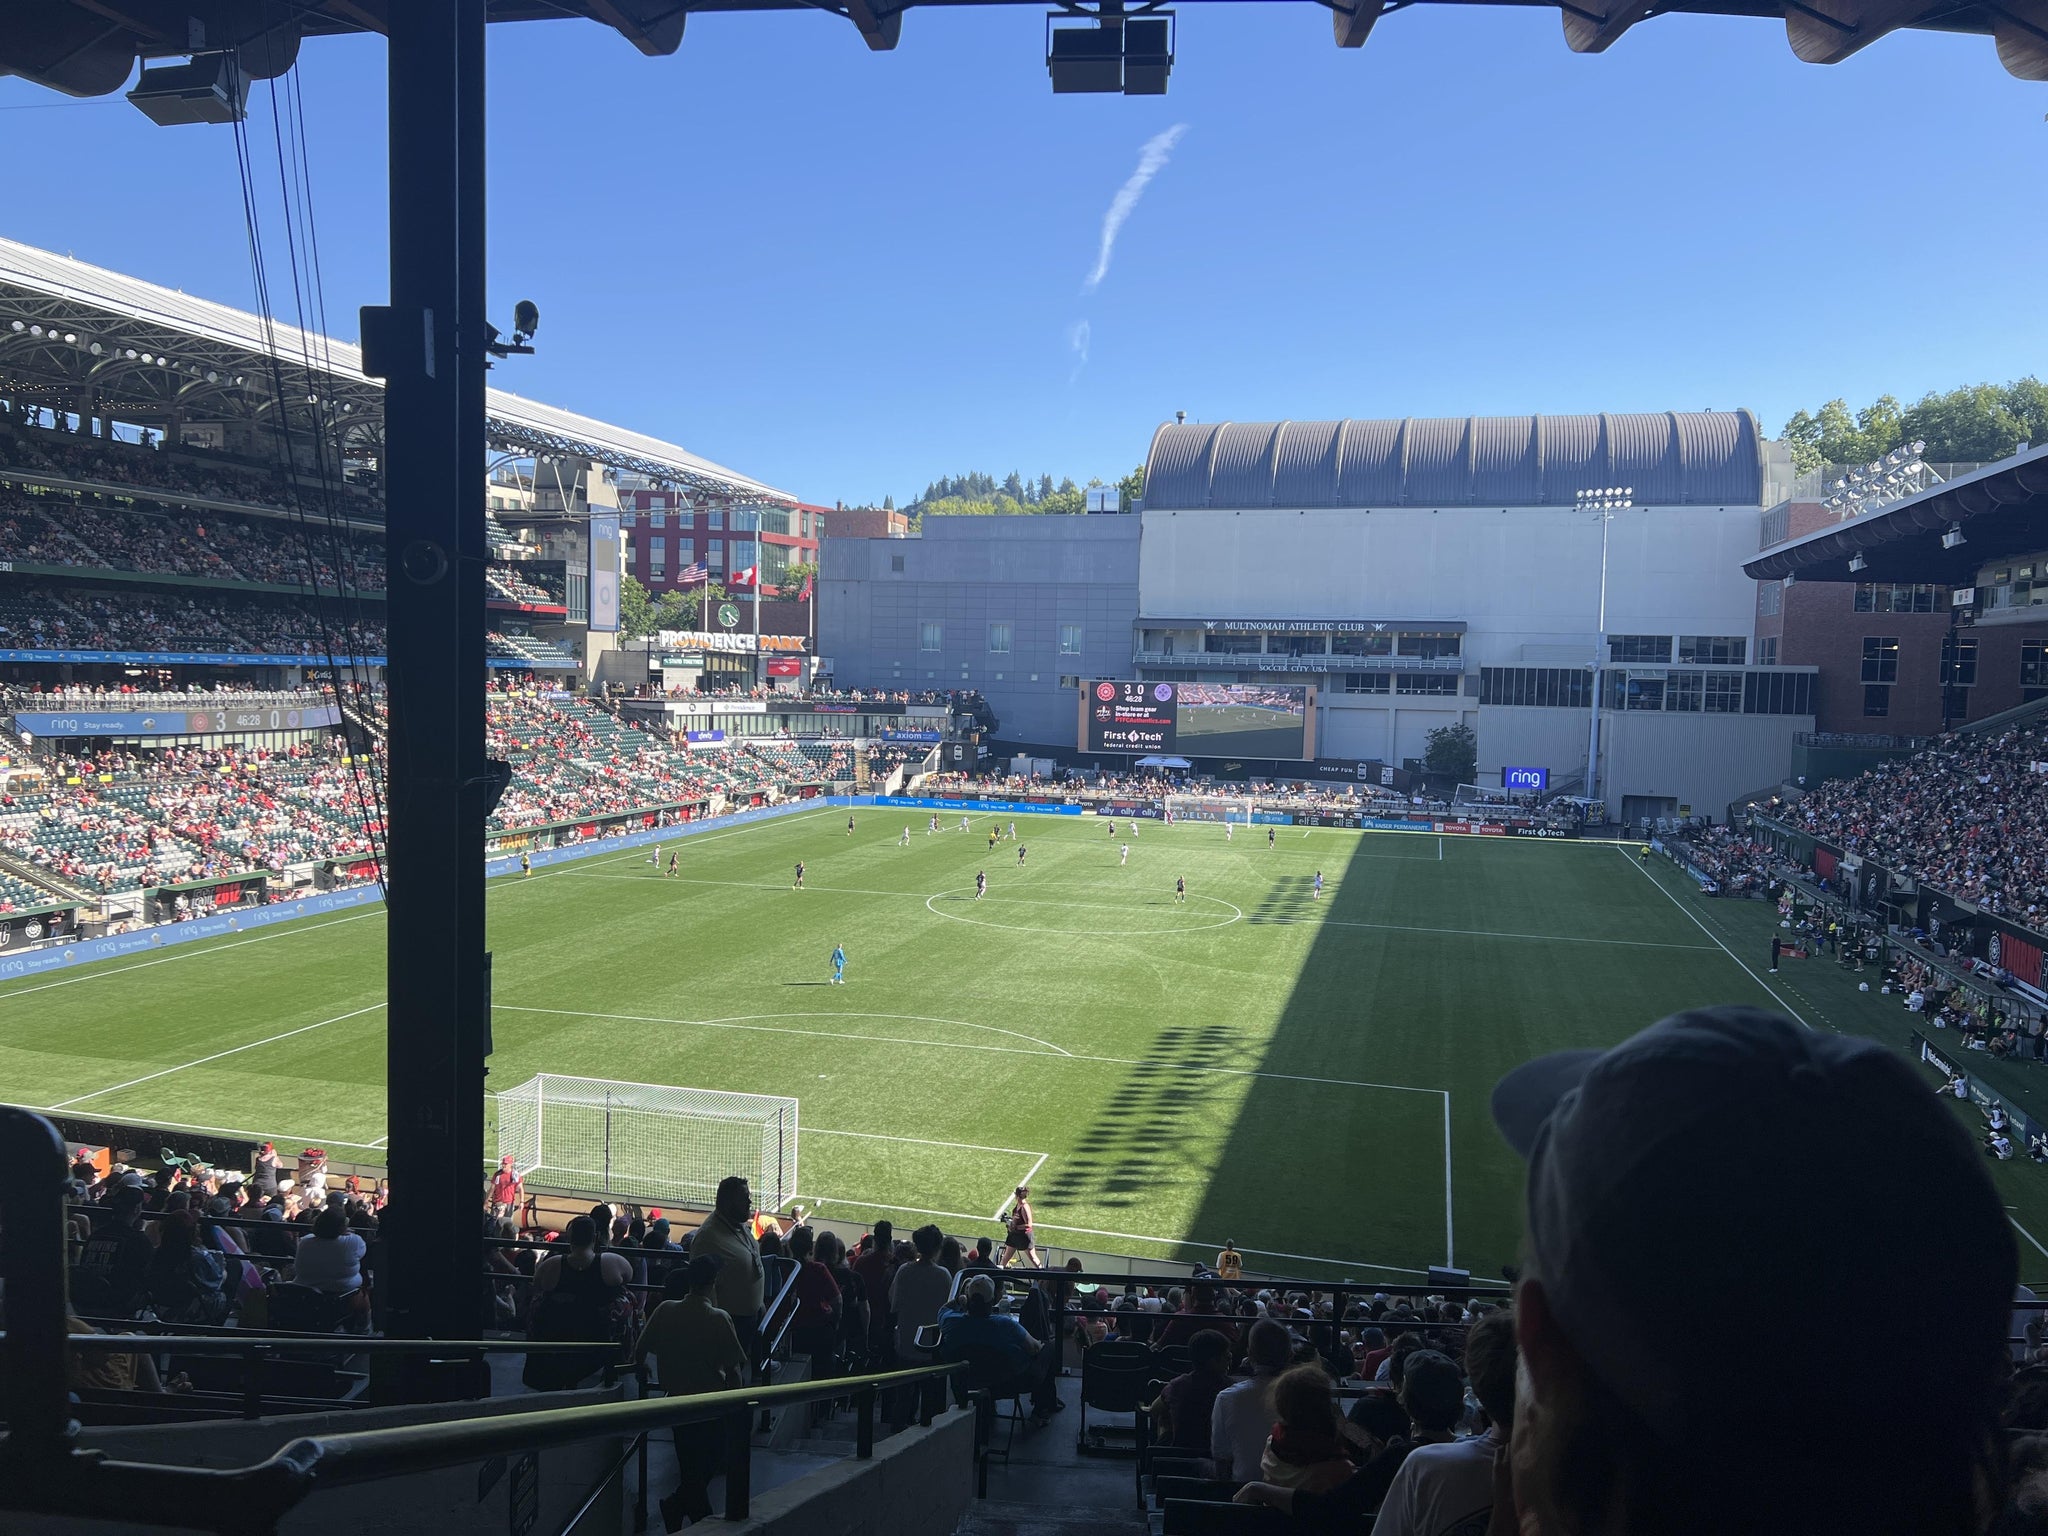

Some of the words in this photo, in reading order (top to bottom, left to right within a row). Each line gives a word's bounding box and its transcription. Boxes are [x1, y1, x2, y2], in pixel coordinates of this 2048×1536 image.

[1224, 622, 1285, 631] MULTNOMAH
[1288, 622, 1334, 631] ATHLETIC
[1338, 622, 1364, 631] CLUB
[659, 630, 756, 651] PROVIDENCE
[759, 635, 806, 652] PARK
[1258, 664, 1288, 672] SOCCER
[1290, 665, 1309, 673] CITY
[1312, 665, 1328, 673] USA
[1124, 684, 1131, 694] 3
[1138, 685, 1144, 694] 0
[51, 717, 78, 731] ring
[84, 722, 100, 730] Stay
[216, 711, 226, 733] 3
[236, 714, 261, 726] 46:28
[270, 710, 280, 730] 0
[896, 731, 922, 740] axiom
[1104, 731, 1126, 740] First
[1140, 732, 1162, 741] Tech
[1511, 769, 1540, 787] ring
[1100, 807, 1114, 816] ally
[1121, 808, 1135, 816] ally
[1142, 809, 1156, 818] ally
[501, 833, 530, 850] PARK
[253, 910, 270, 922] ring
[180, 924, 198, 937] ring
[96, 942, 116, 954] ring
[119, 942, 130, 950] Stay
[1, 960, 24, 974] ring
[27, 960, 42, 968] Stay
